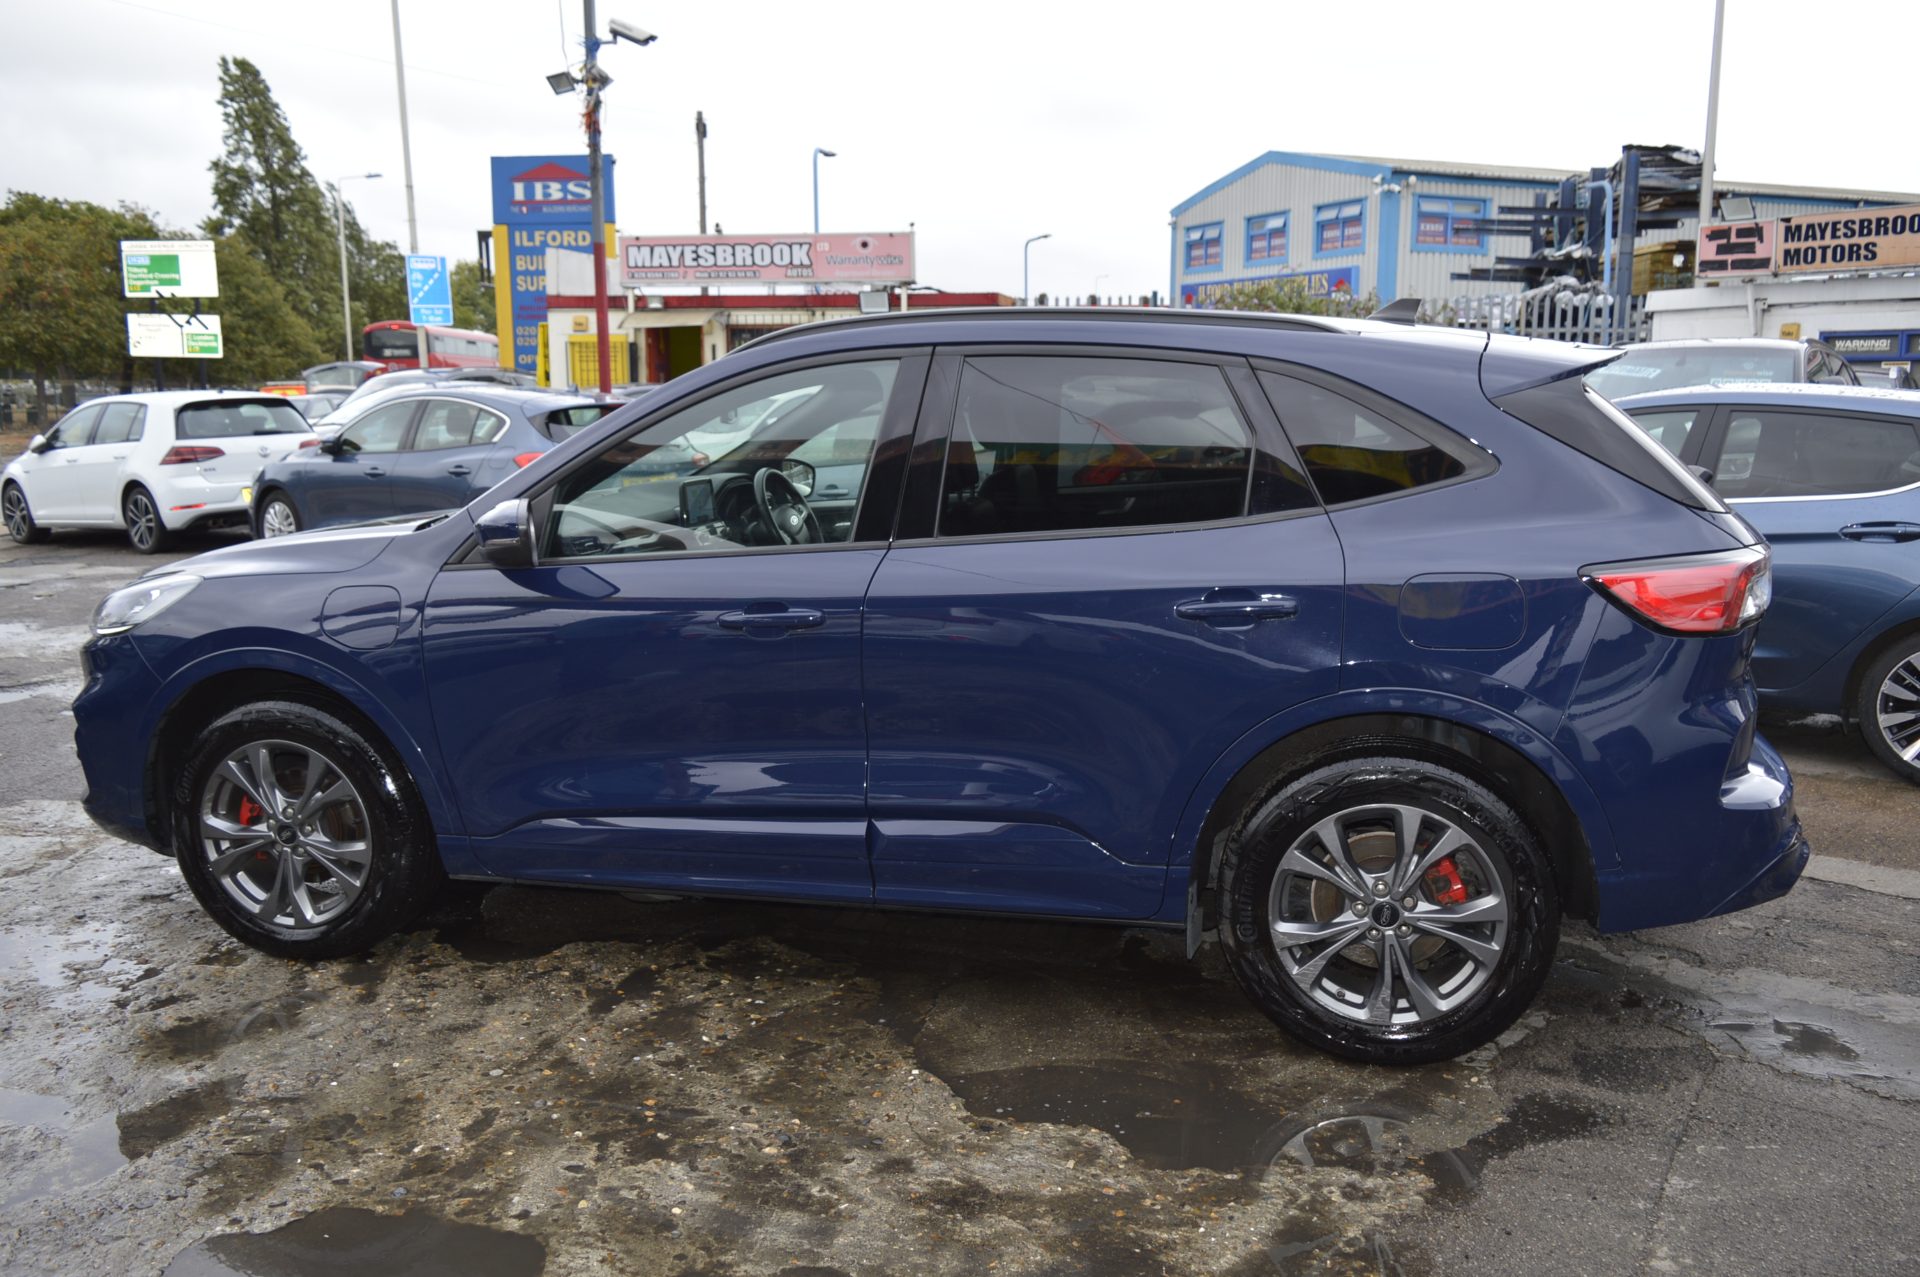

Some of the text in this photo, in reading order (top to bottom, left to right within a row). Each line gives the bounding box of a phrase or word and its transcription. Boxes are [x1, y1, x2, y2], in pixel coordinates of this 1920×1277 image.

[513, 180, 593, 201] IBS
[515, 230, 591, 247] ILFORD
[626, 242, 813, 268] MAYESBROOK
[1783, 241, 1878, 266] MOTORS
[516, 255, 546, 271] BUI
[786, 268, 813, 278] AUTOS
[1835, 338, 1891, 348] WARNING!
[518, 355, 537, 364] OP
